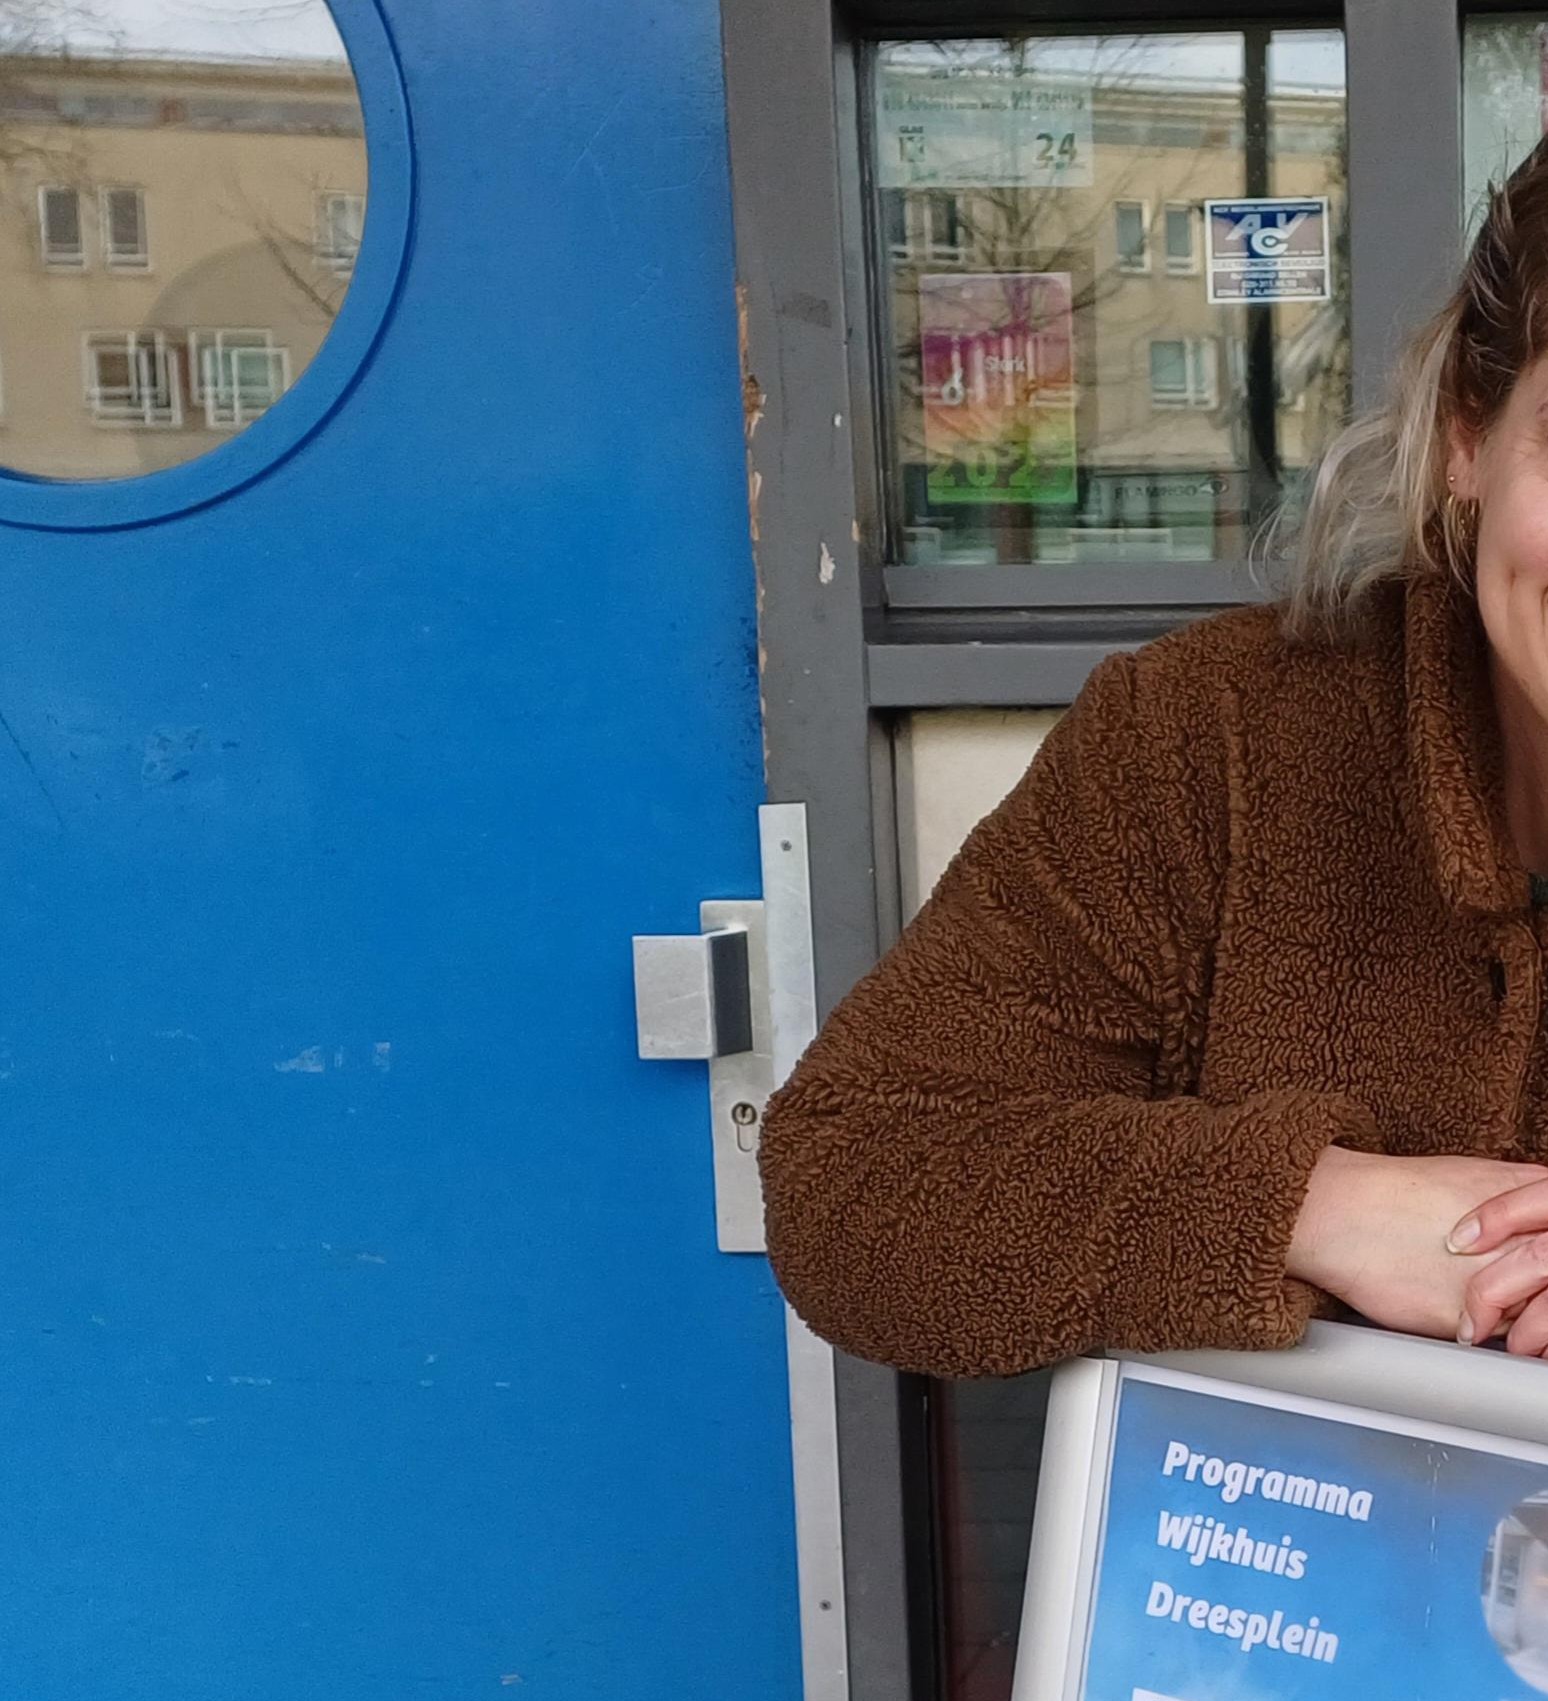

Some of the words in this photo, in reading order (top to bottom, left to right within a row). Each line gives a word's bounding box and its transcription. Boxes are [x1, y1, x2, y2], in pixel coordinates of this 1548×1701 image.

[1162, 1440, 1374, 1522] Programma
[1156, 1509, 1308, 1580] Wijkhuis
[1145, 1580, 1340, 1664] Dreesplein
